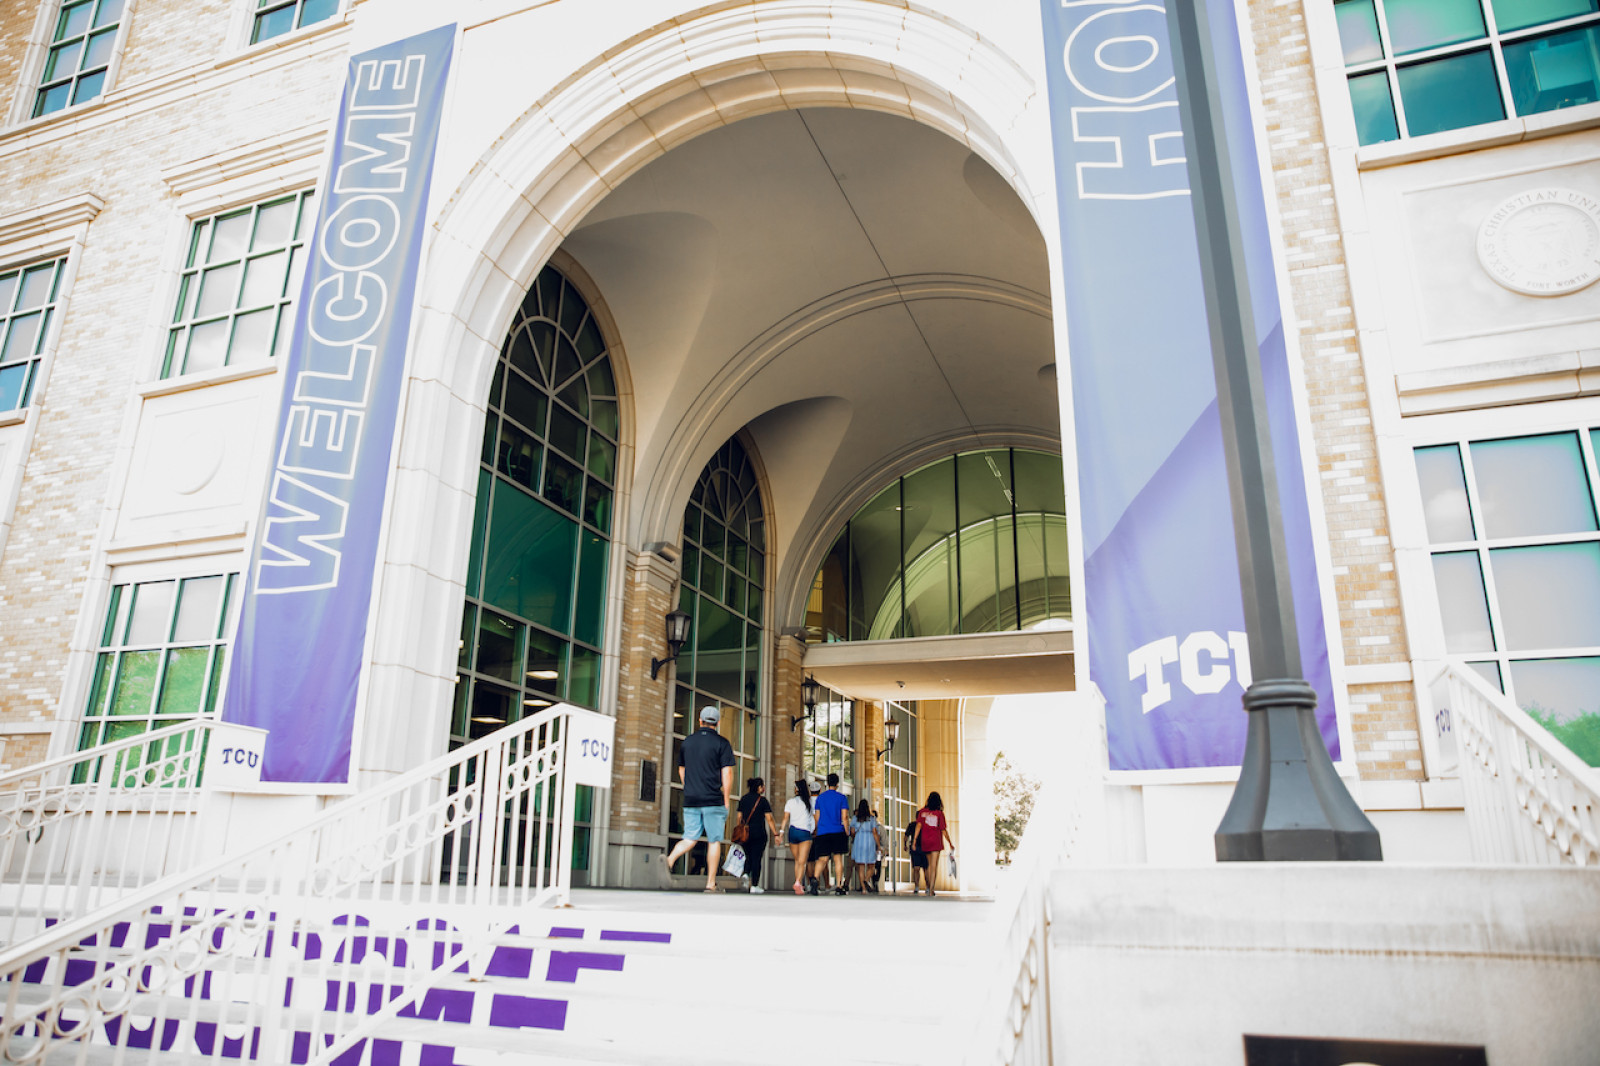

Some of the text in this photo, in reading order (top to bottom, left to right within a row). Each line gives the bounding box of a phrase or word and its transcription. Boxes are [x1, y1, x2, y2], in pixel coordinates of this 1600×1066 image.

[1061, 0, 1191, 199] HO
[1484, 190, 1558, 237] CHRISTIAN
[1483, 242, 1516, 282] TEXAS
[253, 54, 426, 595] WELCOME
[222, 747, 259, 768] TCU
[581, 738, 609, 762] TCU
